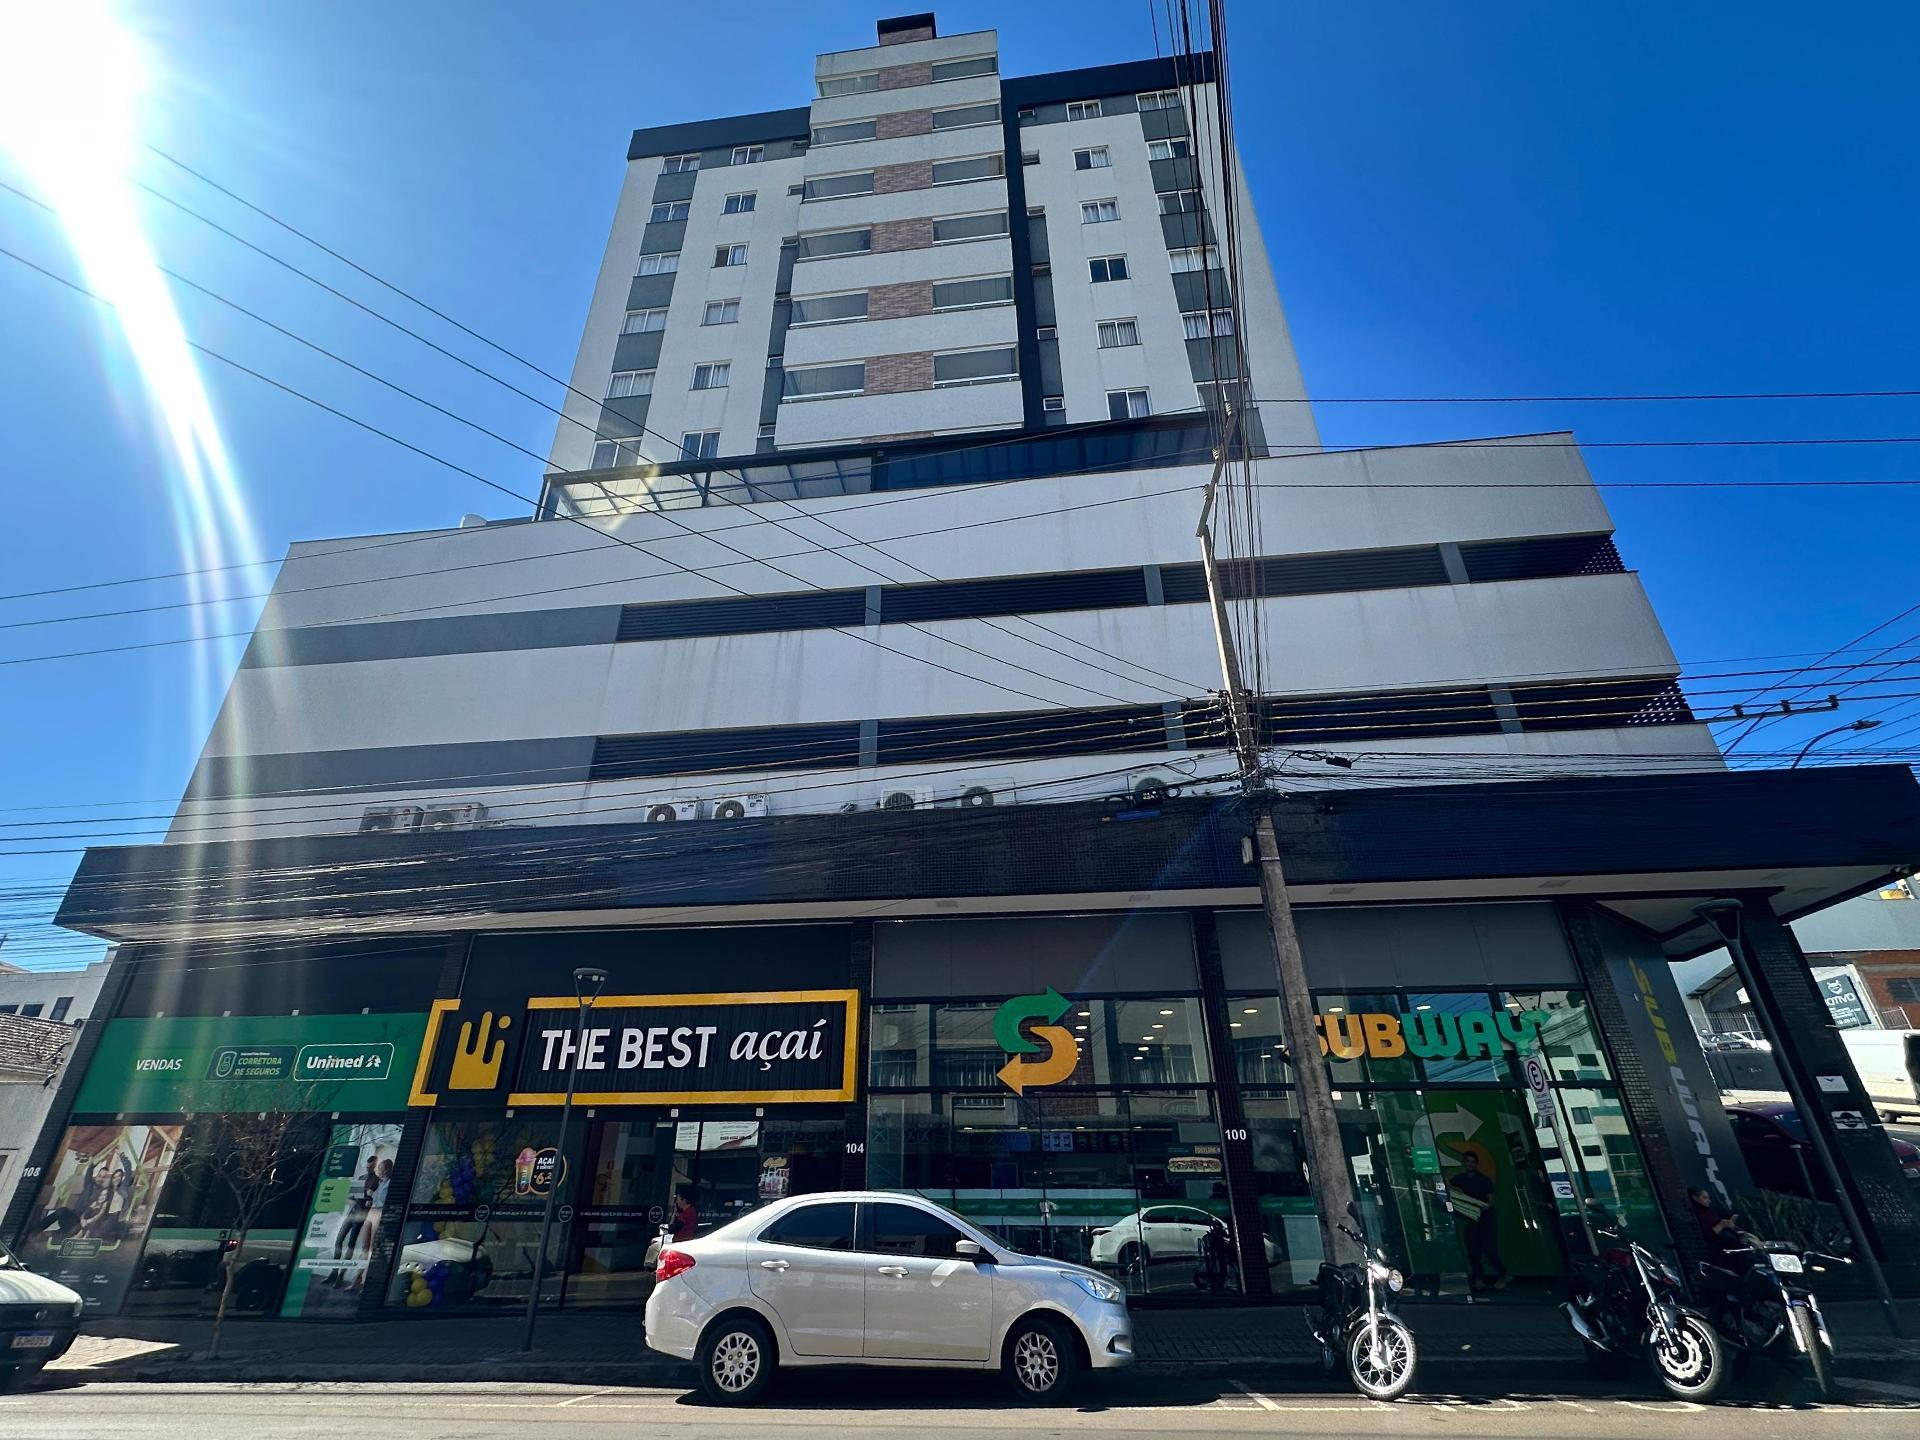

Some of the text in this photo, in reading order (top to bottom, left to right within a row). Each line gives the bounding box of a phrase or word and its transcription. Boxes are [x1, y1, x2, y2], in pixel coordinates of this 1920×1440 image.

[1825, 992, 1856, 1006] OTIVO
[541, 1018, 827, 1071] THE BEST açaí
[135, 1058, 183, 1071] VENDAS
[237, 1057, 282, 1065] CORRETORA
[306, 1055, 364, 1069] Unimed
[234, 1067, 280, 1076] DE SEGUROS
[1628, 956, 1732, 1211] SUBWAY
[1225, 1129, 1247, 1140] 100
[845, 1142, 865, 1154] 104
[537, 1156, 556, 1166] AÇAÍ
[23, 1167, 41, 1177] 108
